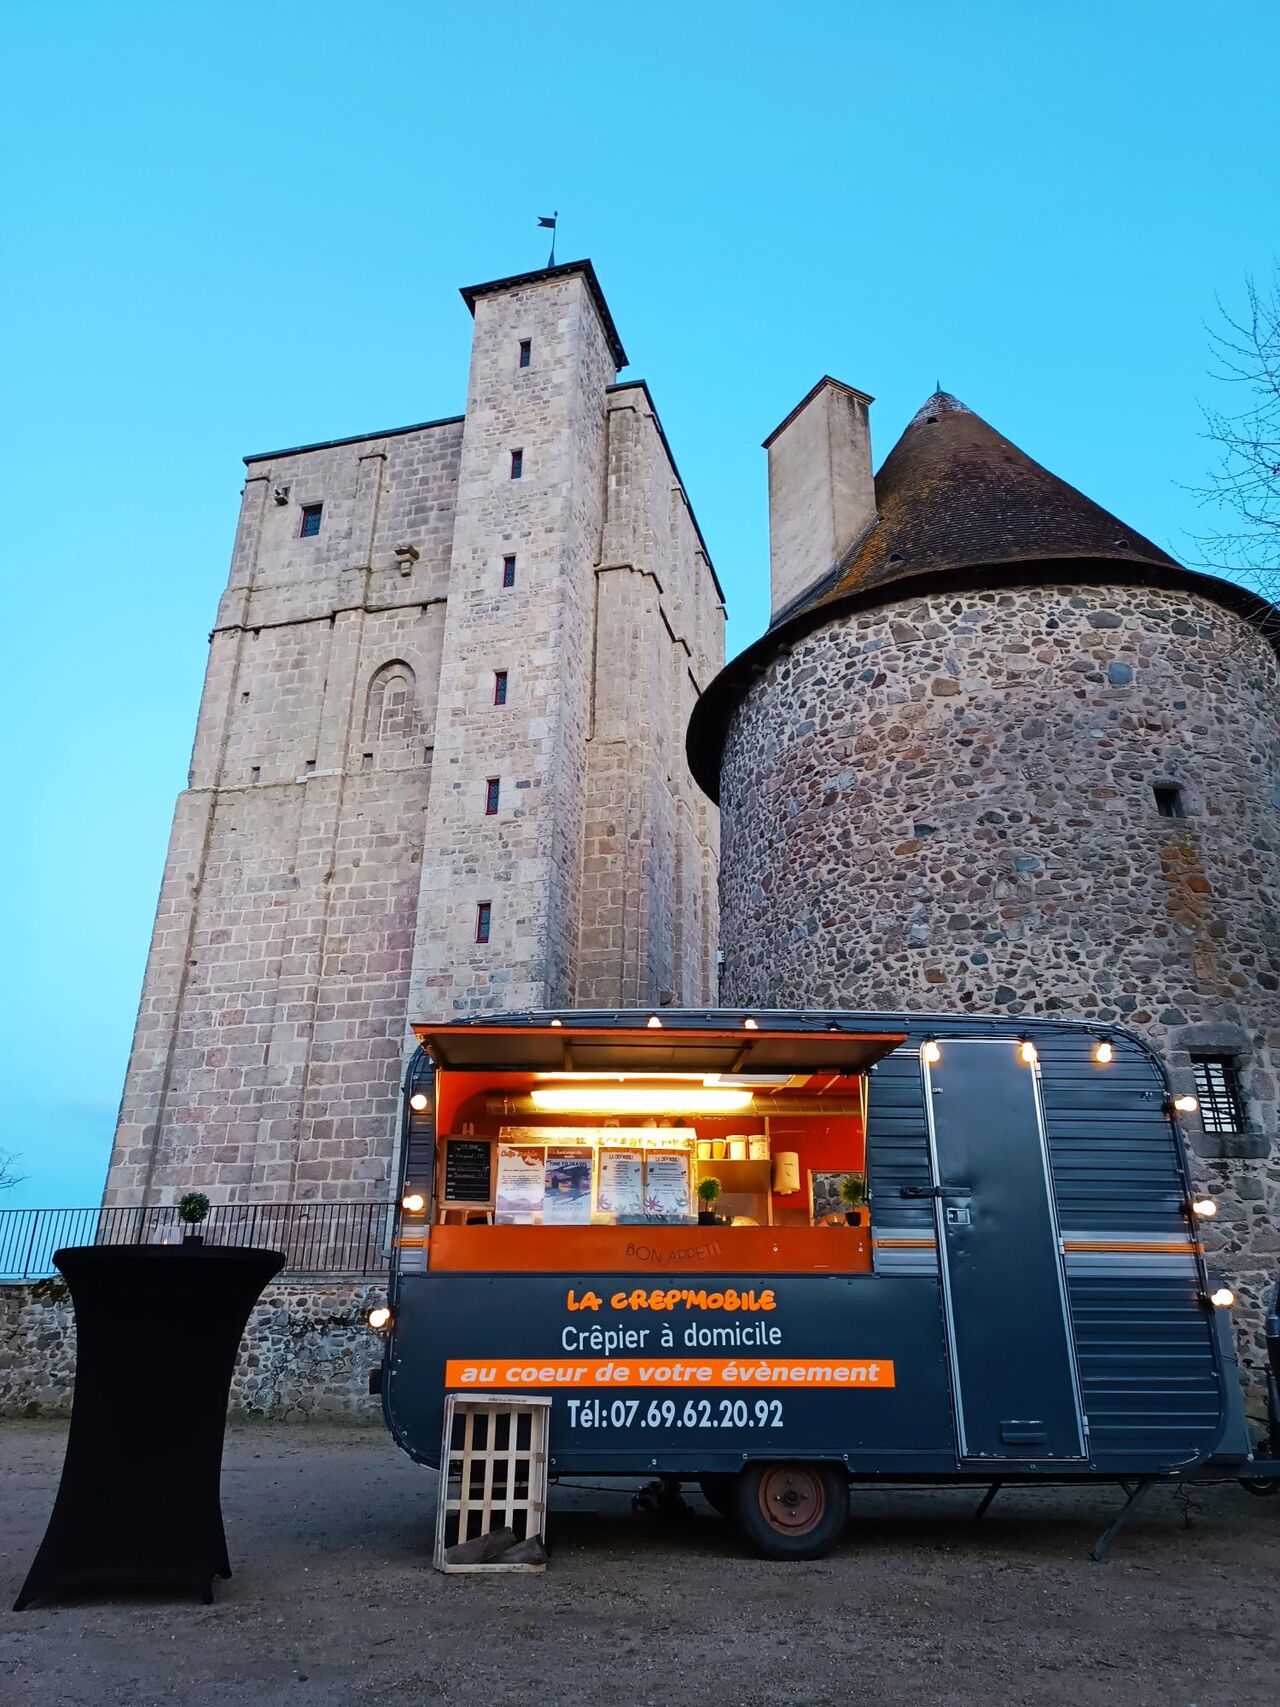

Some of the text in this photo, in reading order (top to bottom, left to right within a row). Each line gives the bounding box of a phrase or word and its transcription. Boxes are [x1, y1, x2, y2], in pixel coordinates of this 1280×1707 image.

[625, 1242, 662, 1263] BON
[567, 1289, 777, 1312] LA CREP'MOBILE
[562, 1321, 782, 1355] Crêpier à domicile
[460, 1361, 879, 1382] au coeur de votre évènement
